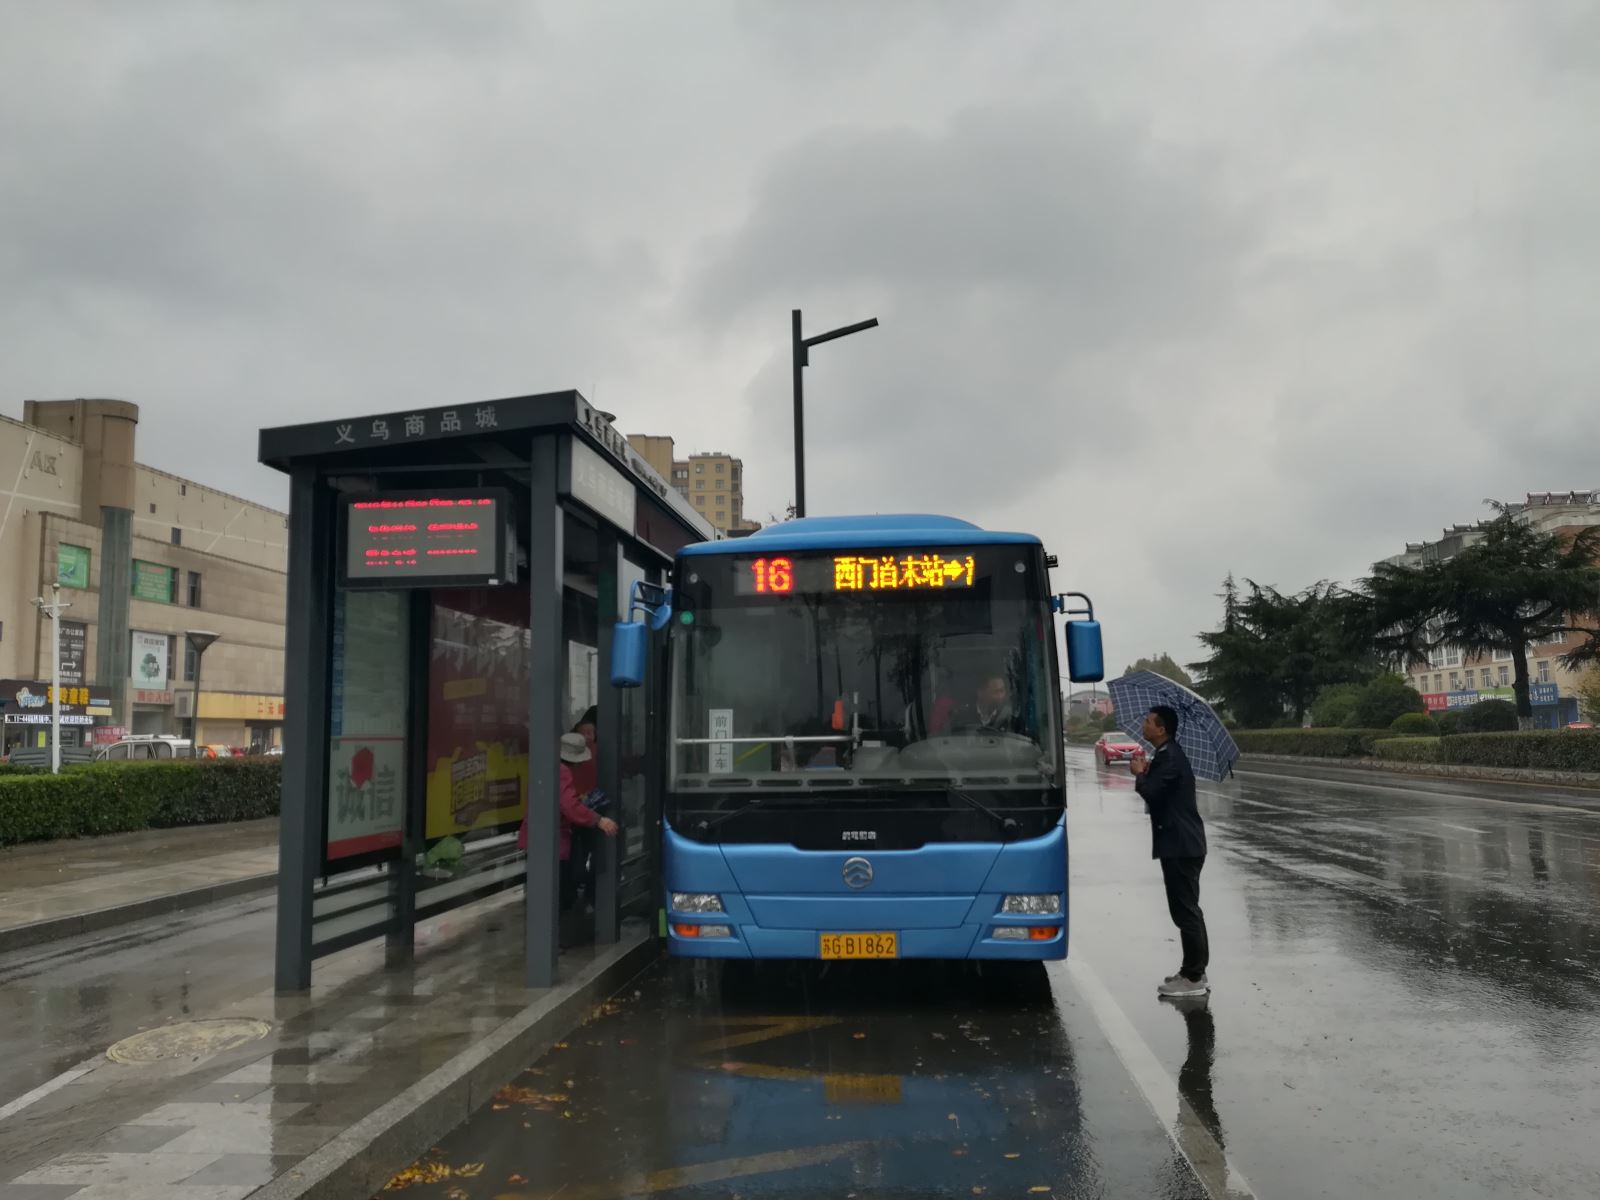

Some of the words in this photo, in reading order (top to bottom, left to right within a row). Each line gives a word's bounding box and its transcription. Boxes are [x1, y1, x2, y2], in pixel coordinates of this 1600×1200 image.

[334, 405, 498, 445] 义乌商品城
[752, 557, 793, 593] 16
[713, 715, 729, 769] 前门上车
